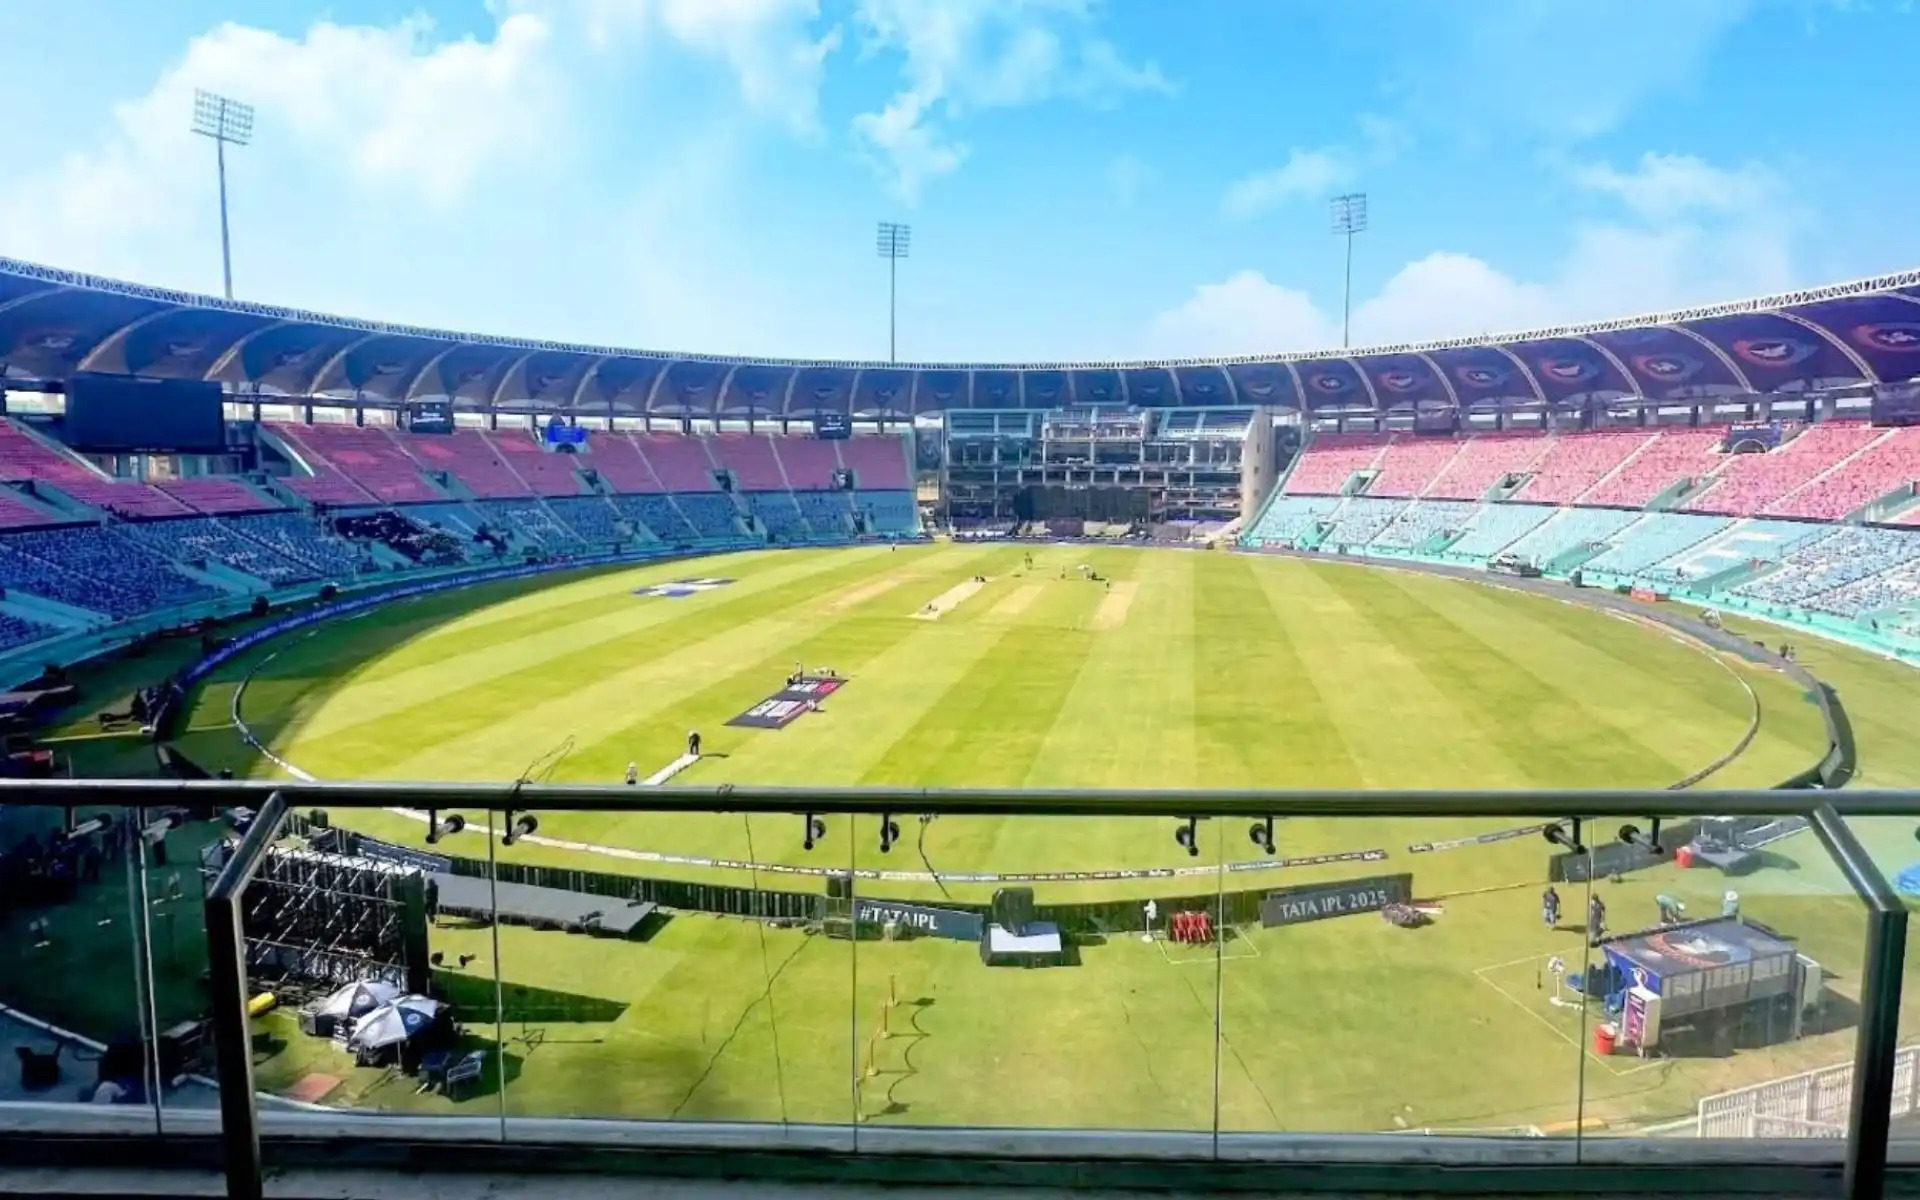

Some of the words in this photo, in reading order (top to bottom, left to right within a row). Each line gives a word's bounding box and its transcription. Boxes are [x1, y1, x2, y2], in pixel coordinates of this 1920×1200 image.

[1280, 900, 1319, 920] TATA
[1321, 894, 1346, 912] IPL
[1350, 890, 1388, 908] 2025
